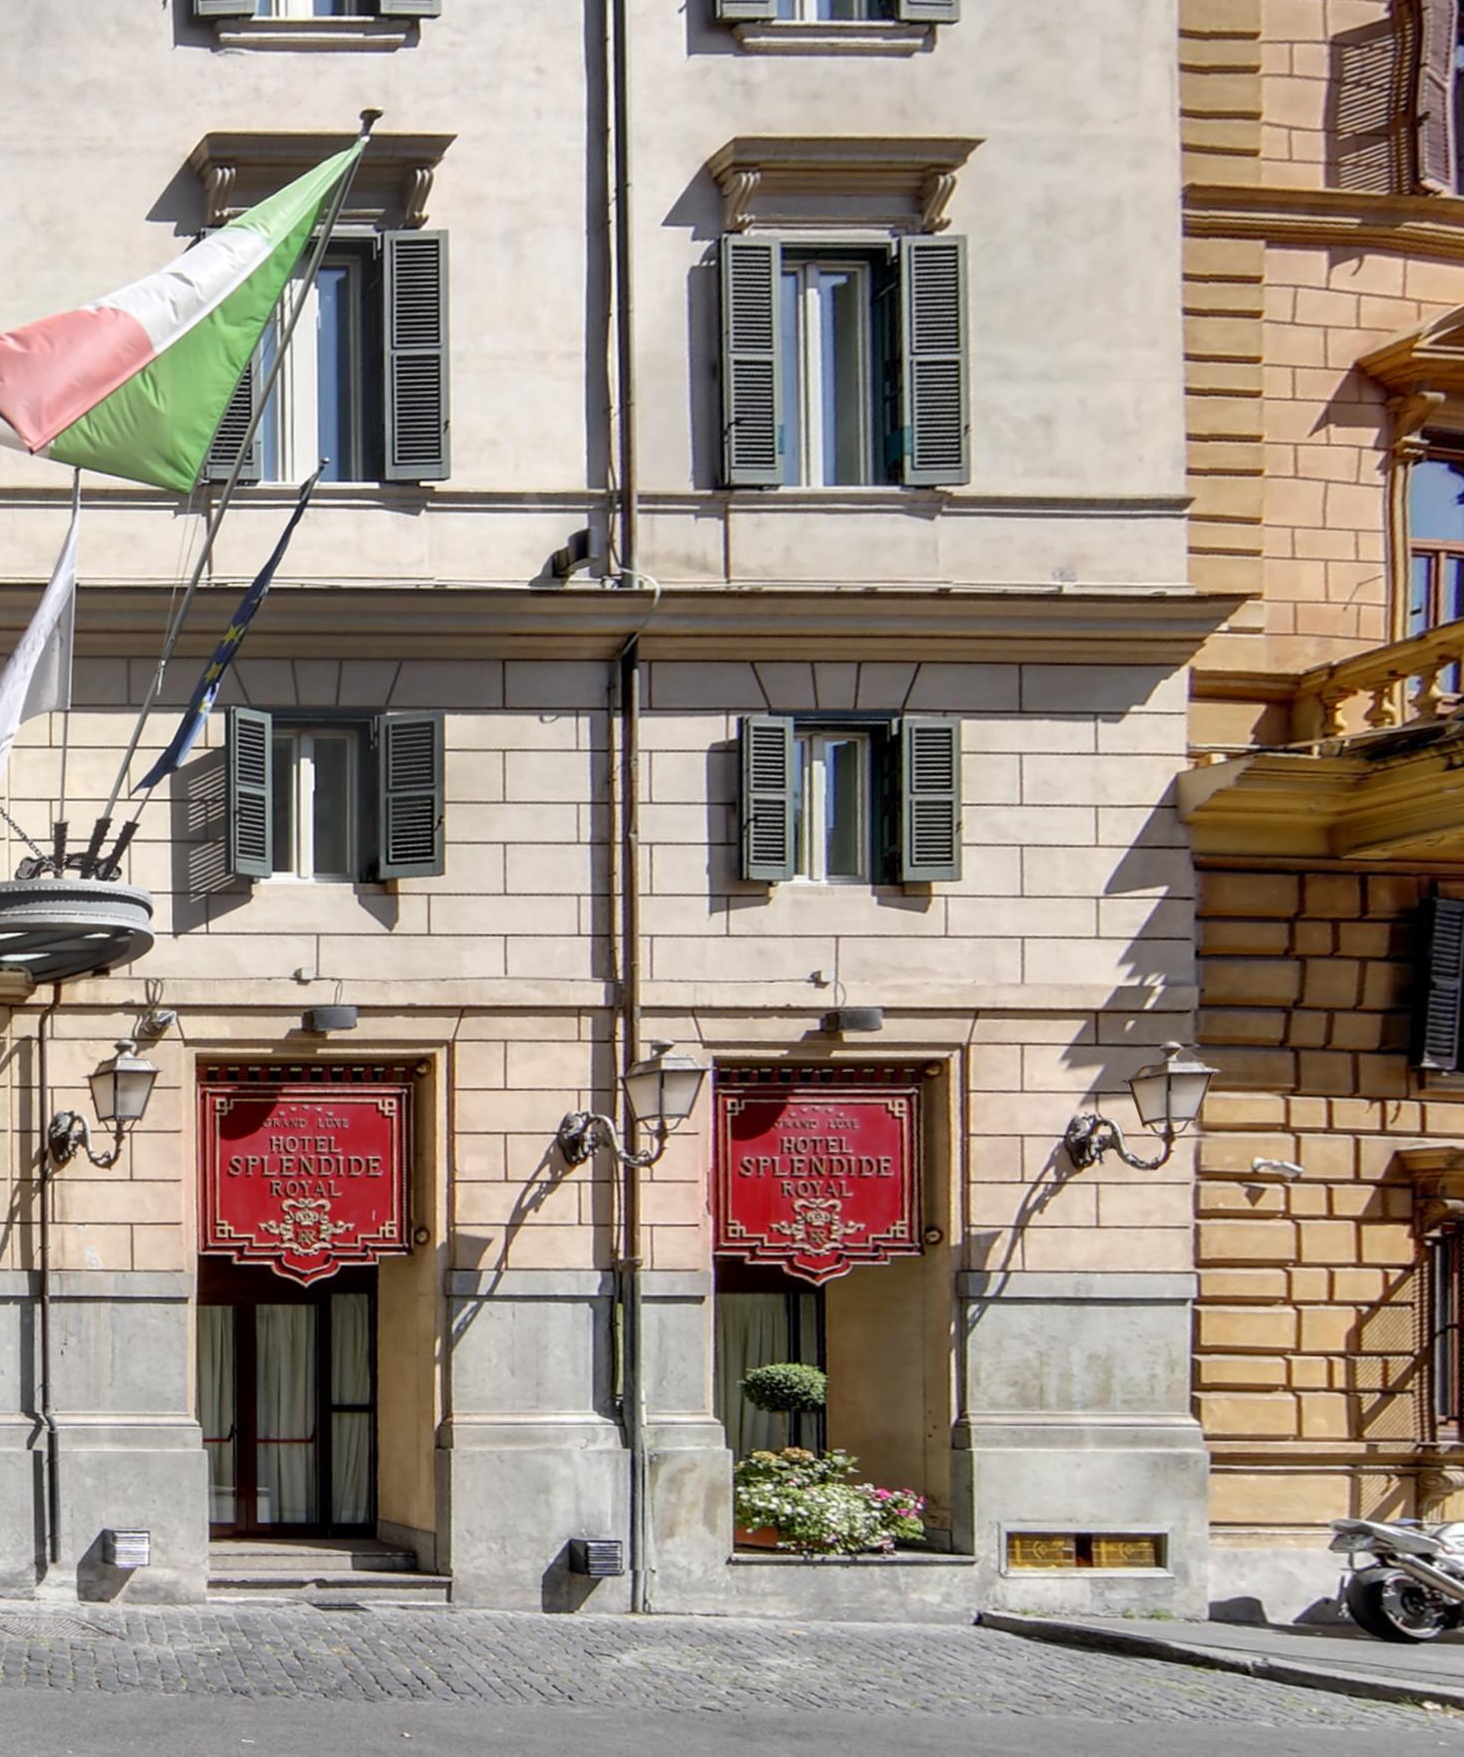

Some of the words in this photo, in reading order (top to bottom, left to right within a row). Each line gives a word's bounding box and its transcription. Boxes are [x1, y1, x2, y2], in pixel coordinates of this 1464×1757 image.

[262, 1118, 307, 1129] GRAND
[316, 1118, 350, 1129] LUXE
[826, 1119, 860, 1130] LUXE
[269, 1135, 342, 1153] HOTEL
[780, 1136, 854, 1154] HOTEL
[227, 1155, 384, 1177] SPLENDIDE
[738, 1156, 894, 1178] SPLENDIDE
[269, 1180, 343, 1197] ROYAL
[780, 1180, 854, 1198] ROYAL
